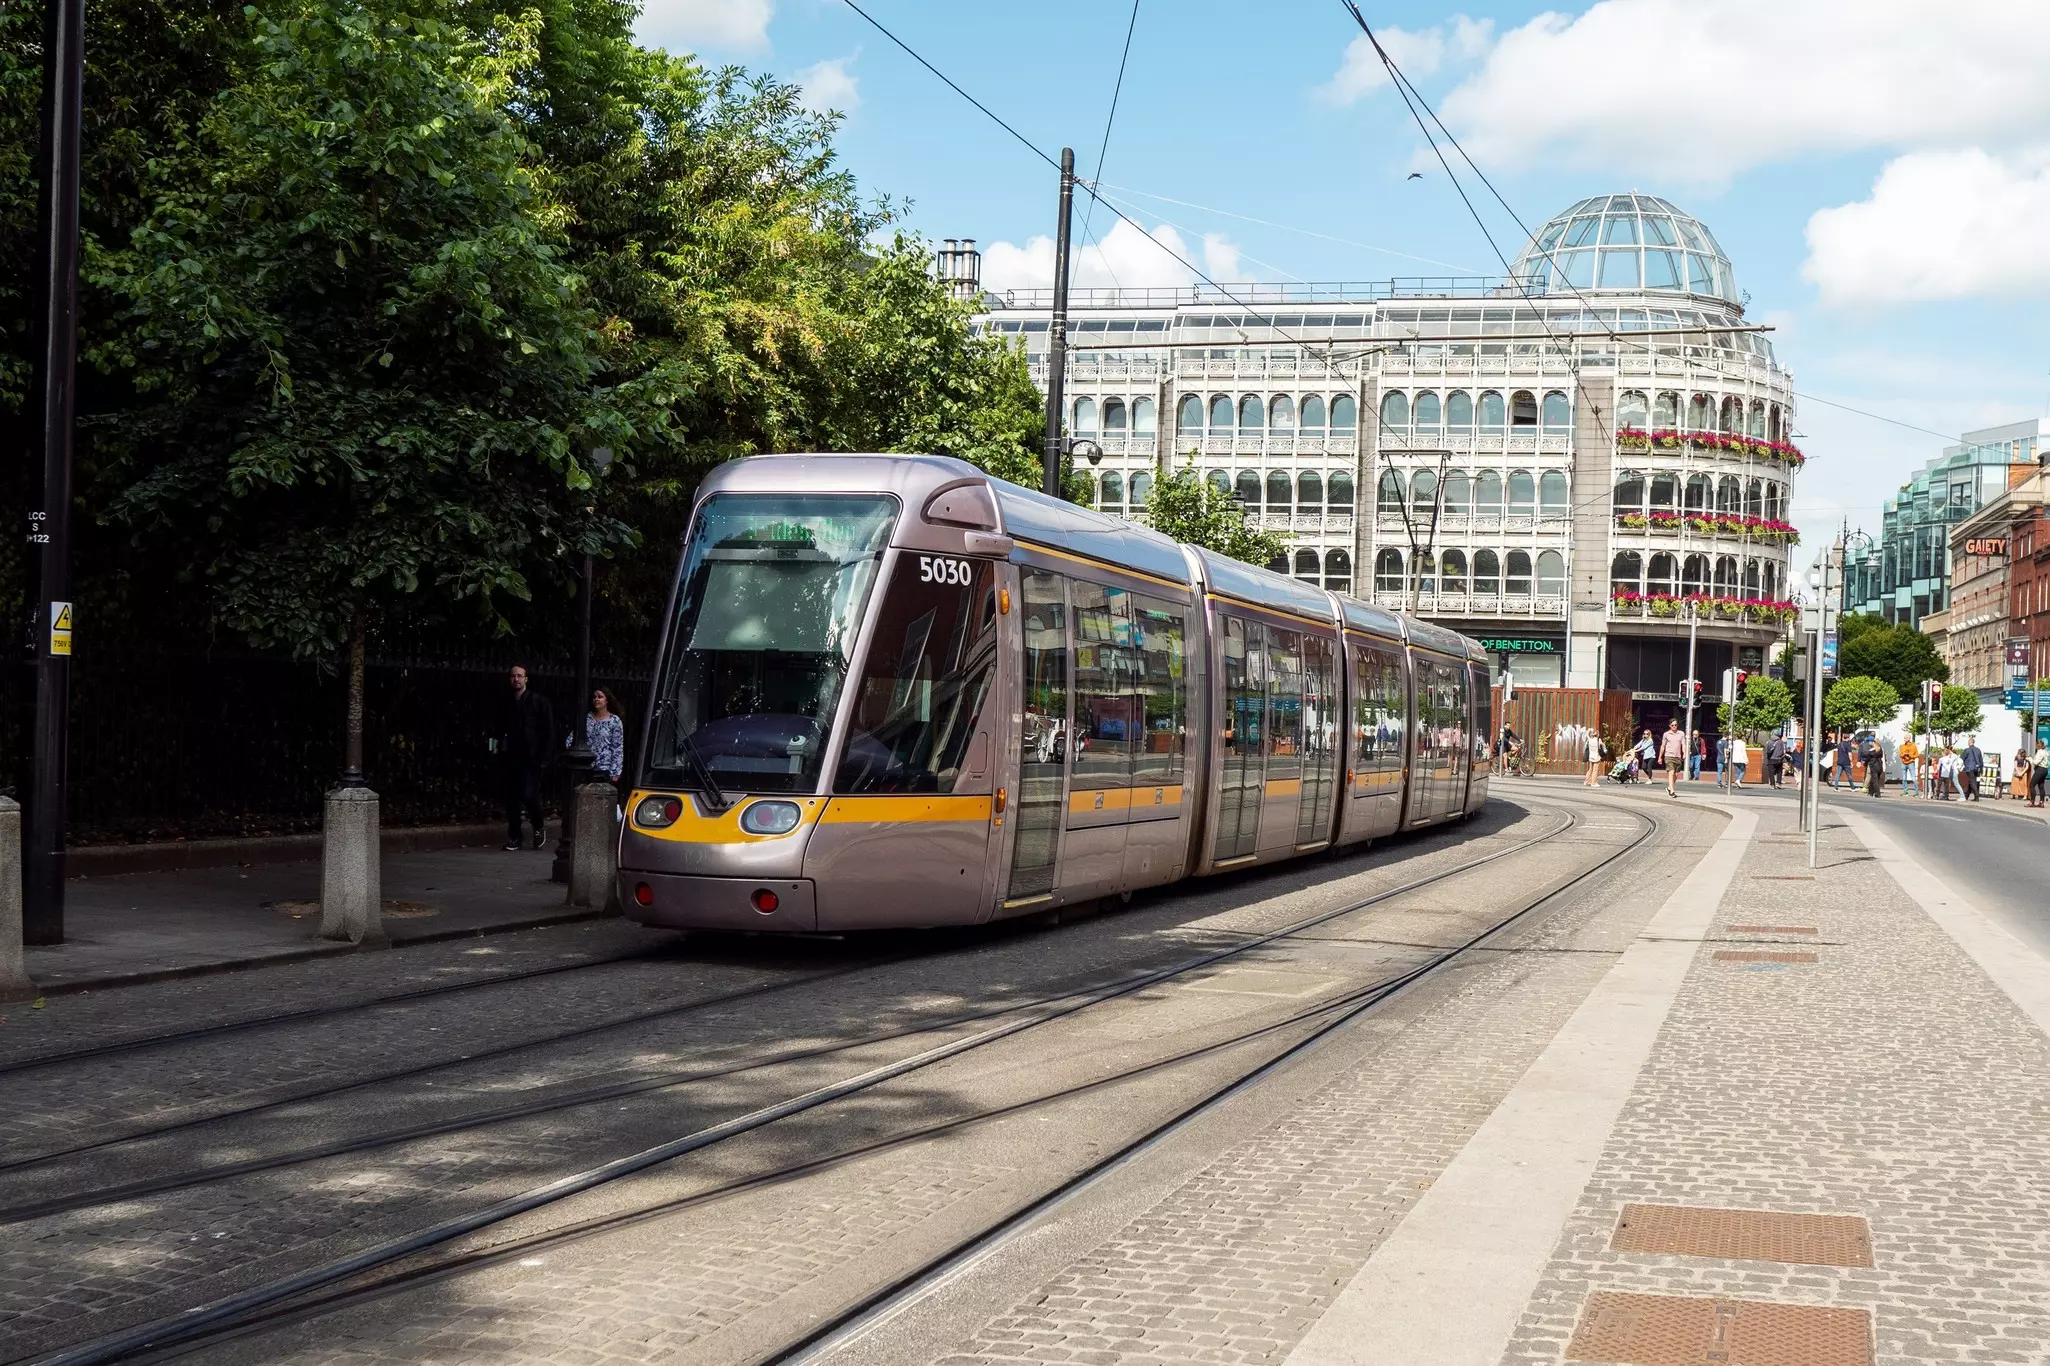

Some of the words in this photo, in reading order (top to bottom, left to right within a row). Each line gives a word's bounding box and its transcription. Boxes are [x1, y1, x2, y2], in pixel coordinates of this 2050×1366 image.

[28, 511, 46, 520] LCC
[32, 522, 39, 531] S
[1965, 538, 2006, 554] GAIETY
[920, 556, 972, 586] 5030
[1480, 639, 1495, 649] OF
